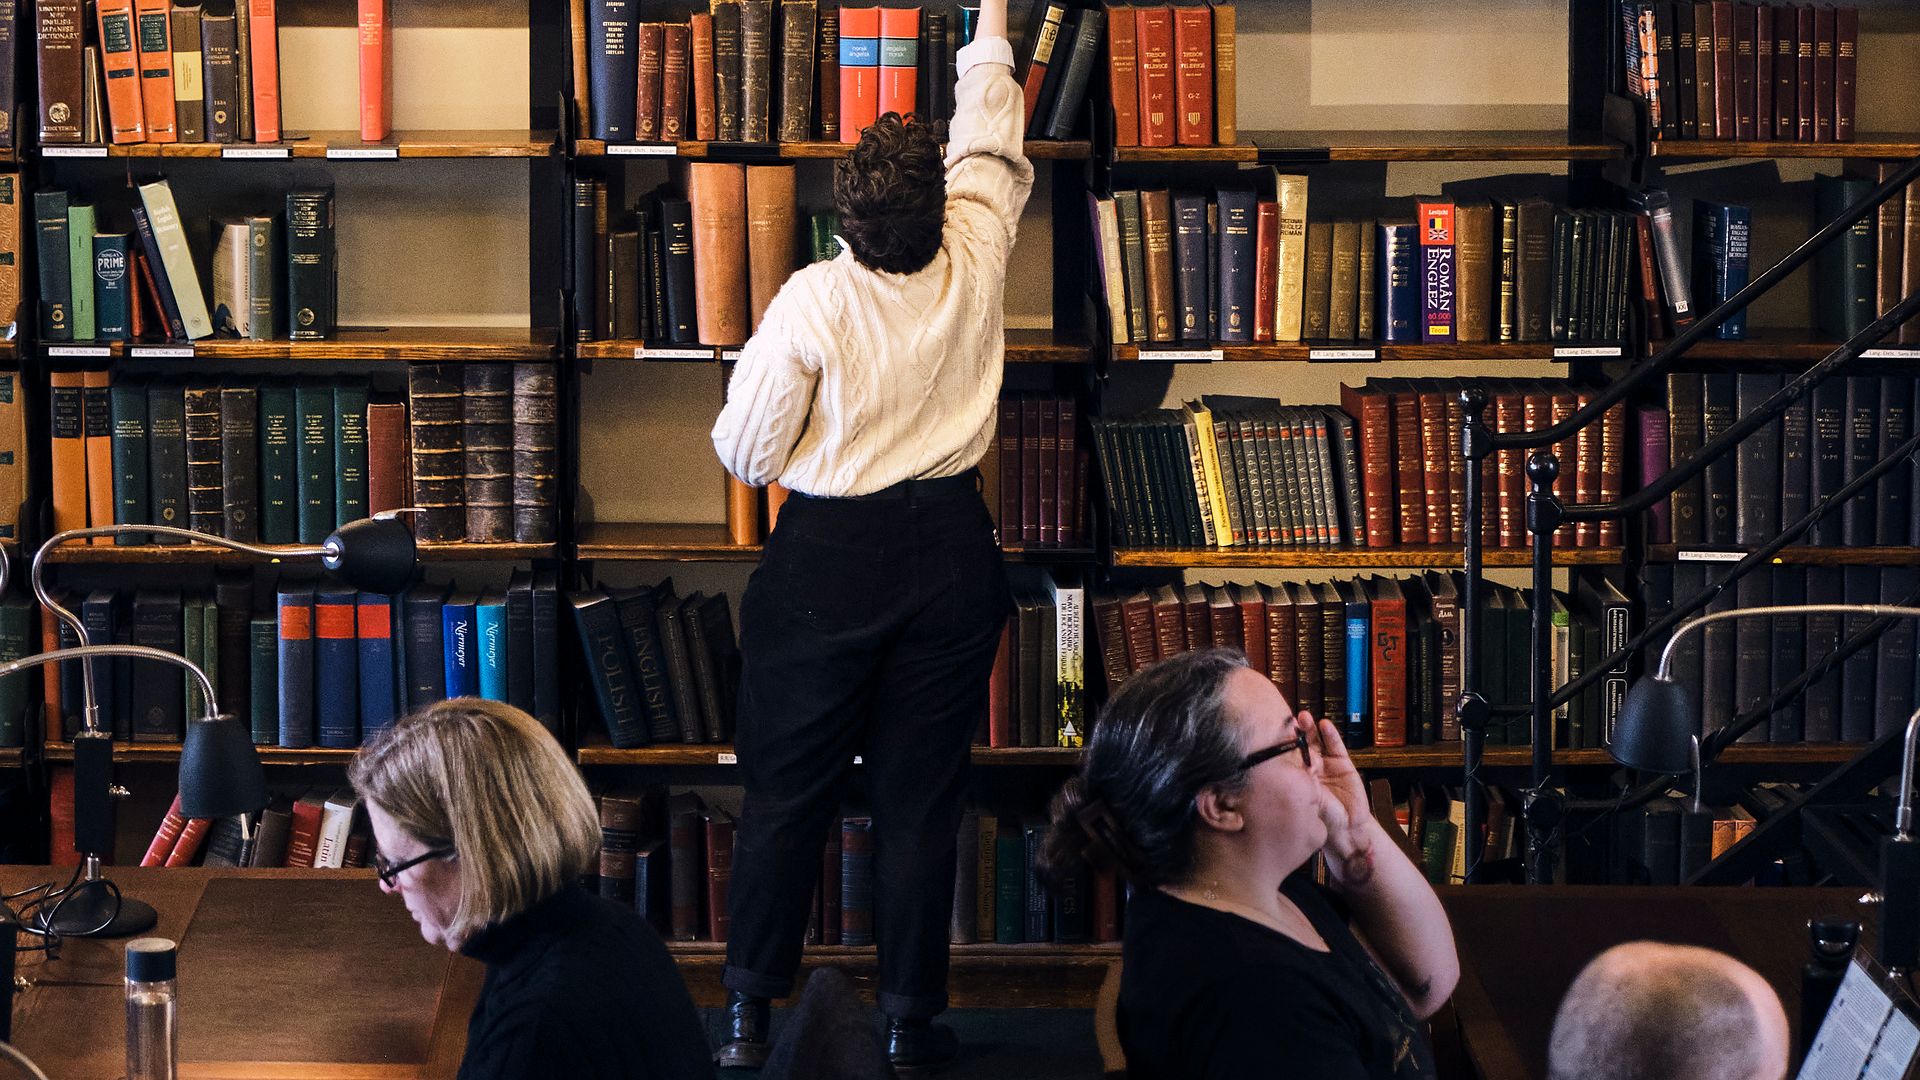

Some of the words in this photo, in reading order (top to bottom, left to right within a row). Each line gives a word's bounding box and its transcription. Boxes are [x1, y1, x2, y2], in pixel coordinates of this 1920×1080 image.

[98, 258, 124, 271] PRIME
[1427, 248, 1439, 309] ENGLEZ
[1439, 248, 1452, 311] ROMÂN
[1247, 450, 1264, 518] СЛОВАРЬ
[1260, 450, 1276, 518] СЛОВАРЬ
[1272, 450, 1288, 517] СЛОВАРЬ
[1284, 449, 1299, 517] СЛОВАРЬ
[1296, 450, 1312, 516] СЛОВАРЬ
[1308, 448, 1324, 516] СЛОВАРЬ
[1347, 449, 1361, 518] СЛОВАРЬ
[455, 620, 468, 668] Niermeyer
[486, 621, 498, 669] Niermeyer
[632, 626, 665, 720] ENGLISH
[598, 636, 633, 724] POLISH
[321, 838, 333, 862] Latin
